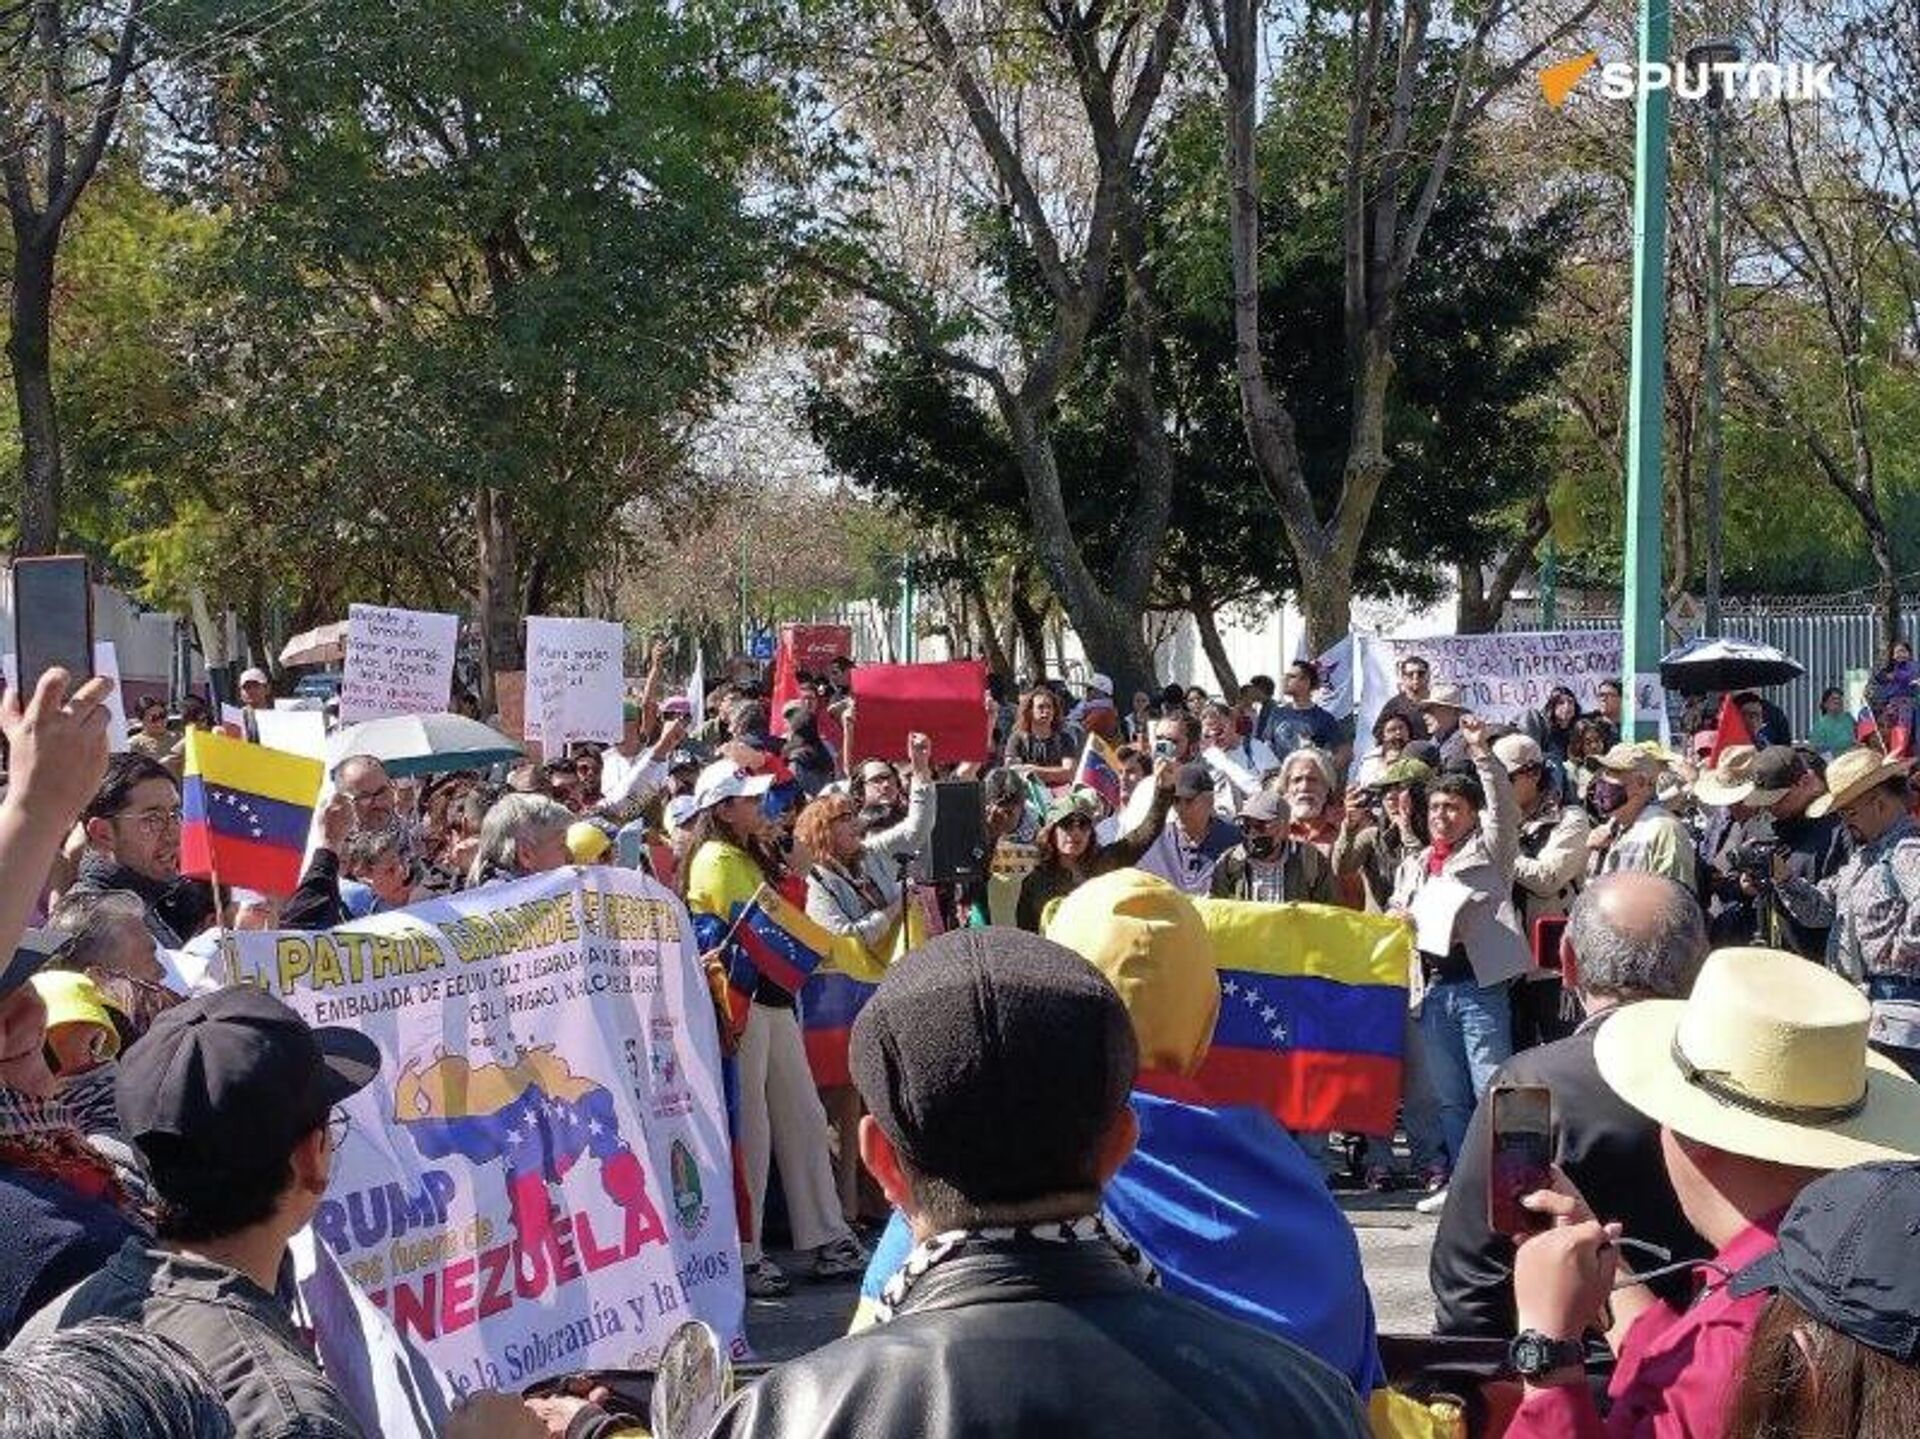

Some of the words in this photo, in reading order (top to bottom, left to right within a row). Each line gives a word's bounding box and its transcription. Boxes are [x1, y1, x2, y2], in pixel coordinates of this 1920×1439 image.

[276, 928, 445, 996] PATRIA
[437, 890, 581, 965] GRANDE
[314, 987, 416, 1025] EMBAJADA
[420, 980, 441, 1004] DE
[313, 1169, 456, 1256] RUMP
[369, 1195, 668, 1342] NEZUELA
[504, 1300, 625, 1382] Soberanía
[626, 1297, 648, 1333] y
[651, 1280, 679, 1316] la
